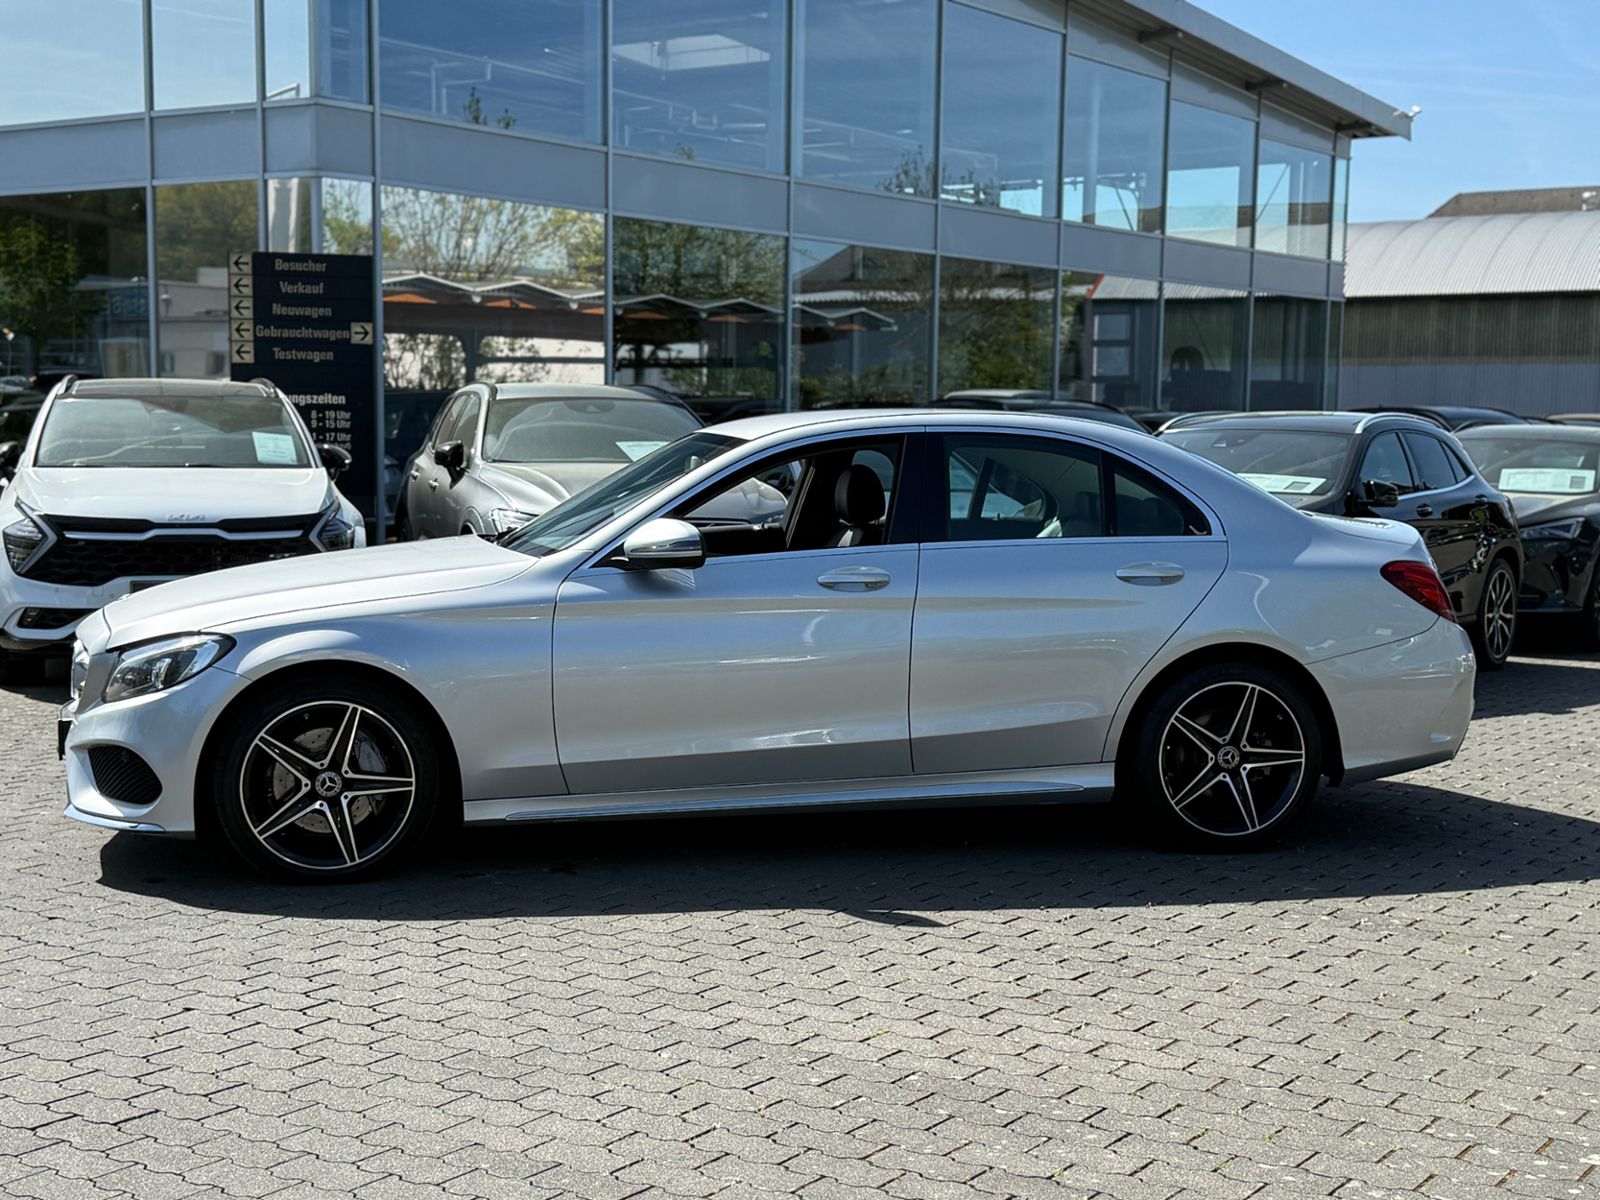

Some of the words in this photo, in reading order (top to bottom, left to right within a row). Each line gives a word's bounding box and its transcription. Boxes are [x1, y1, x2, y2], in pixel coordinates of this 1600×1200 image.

[274, 258, 327, 272] Besucher
[279, 281, 324, 294] Verkauf
[272, 303, 332, 318] Neuwagen
[255, 325, 350, 341] Gebrauchtwagen
[273, 347, 334, 362] Testwagen
[311, 410, 317, 419] 8
[325, 410, 335, 419] 19
[336, 410, 351, 419] Uhr
[311, 419, 317, 428] 9
[325, 419, 335, 428] 15
[336, 419, 351, 428] Uhr
[325, 432, 335, 441] 17
[336, 432, 352, 441] Uhr
